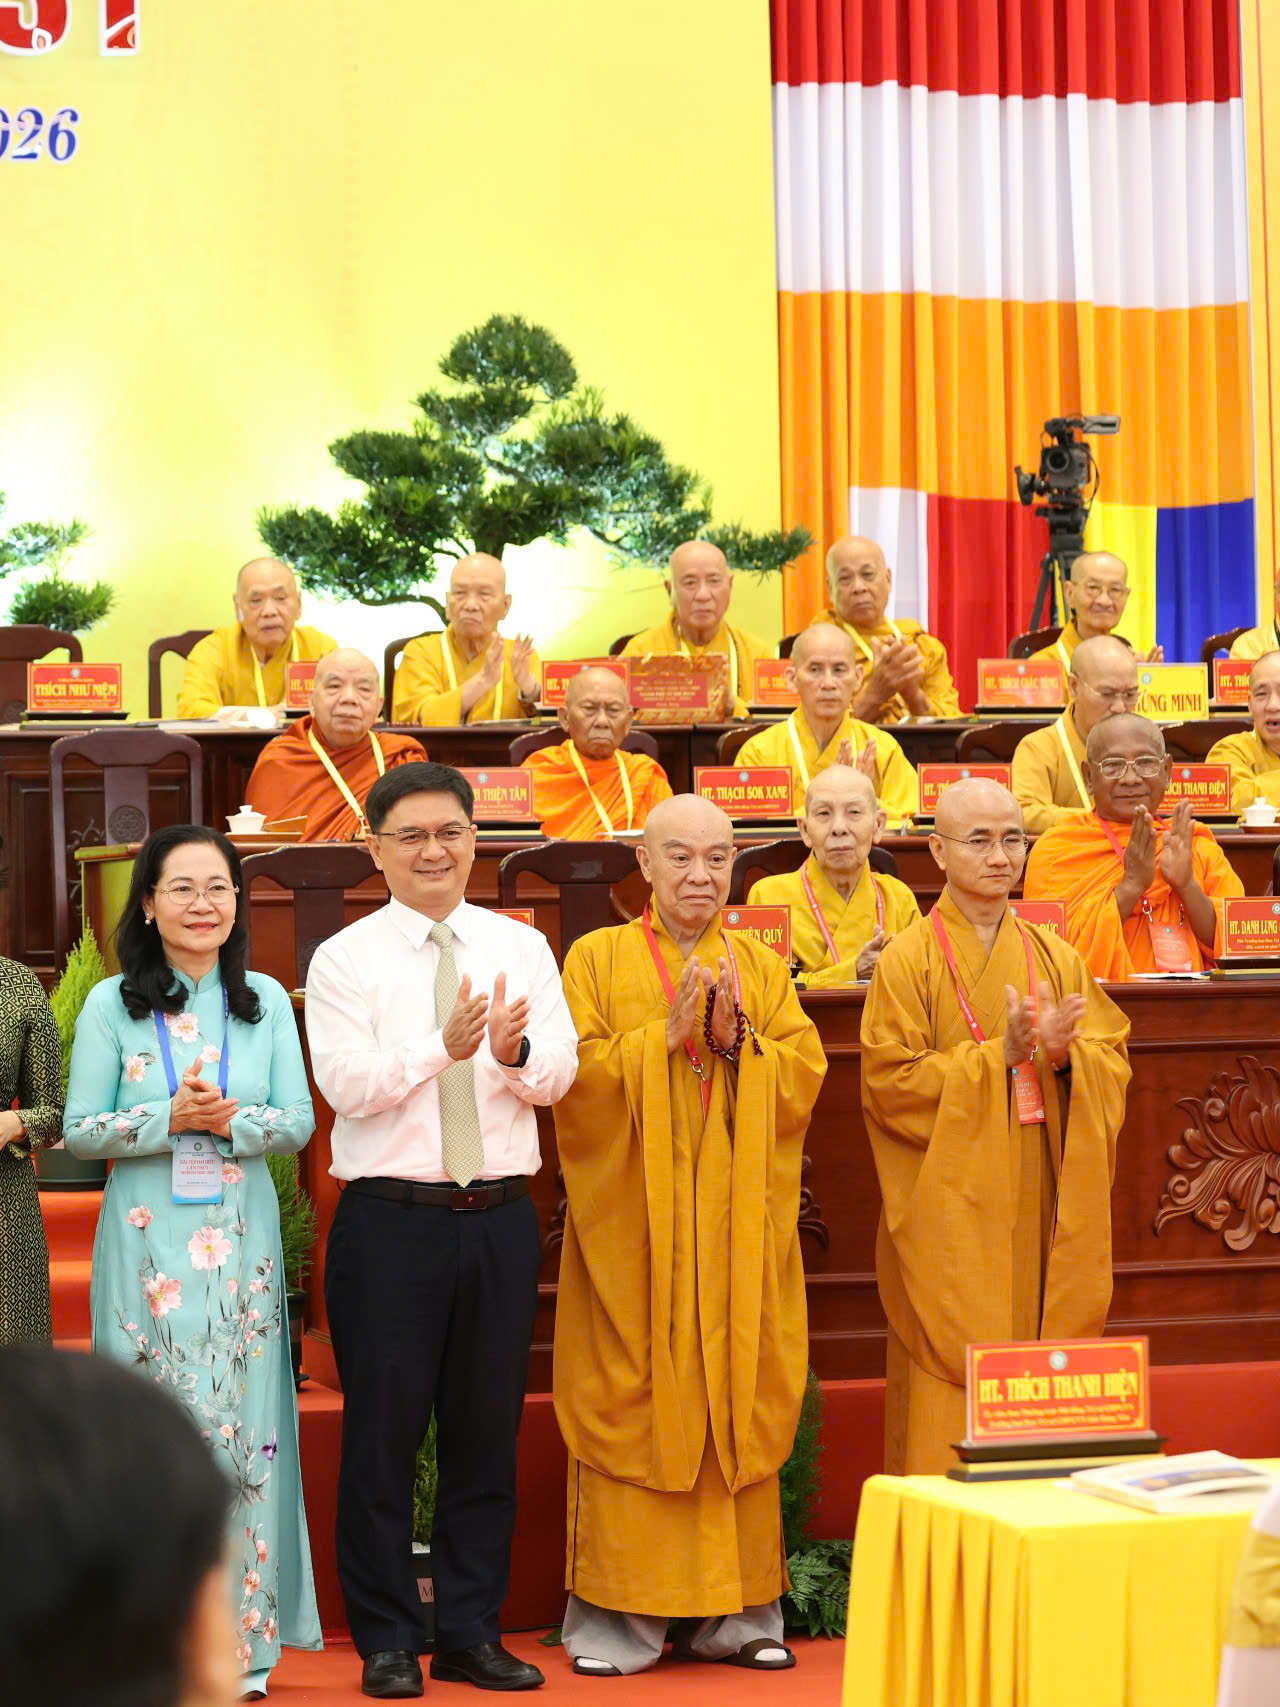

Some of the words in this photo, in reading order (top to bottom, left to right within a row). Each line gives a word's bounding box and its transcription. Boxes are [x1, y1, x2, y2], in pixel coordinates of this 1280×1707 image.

[35, 681, 67, 696] THÍCH
[1171, 693, 1202, 712] MINH
[509, 784, 527, 801] TÂM
[701, 787, 714, 800] HT.
[716, 786, 745, 803] THẠCH
[747, 786, 765, 800] SOK
[766, 785, 787, 800] XANE
[1183, 782, 1208, 796] THANH
[763, 924, 784, 946] QUÝ
[1230, 920, 1240, 934] HT.
[1241, 920, 1260, 934] DANH
[1261, 920, 1278, 934] LUNG
[979, 1378, 1003, 1403] HT.
[1006, 1370, 1050, 1401] THÍCH
[1053, 1374, 1101, 1400] THANH
